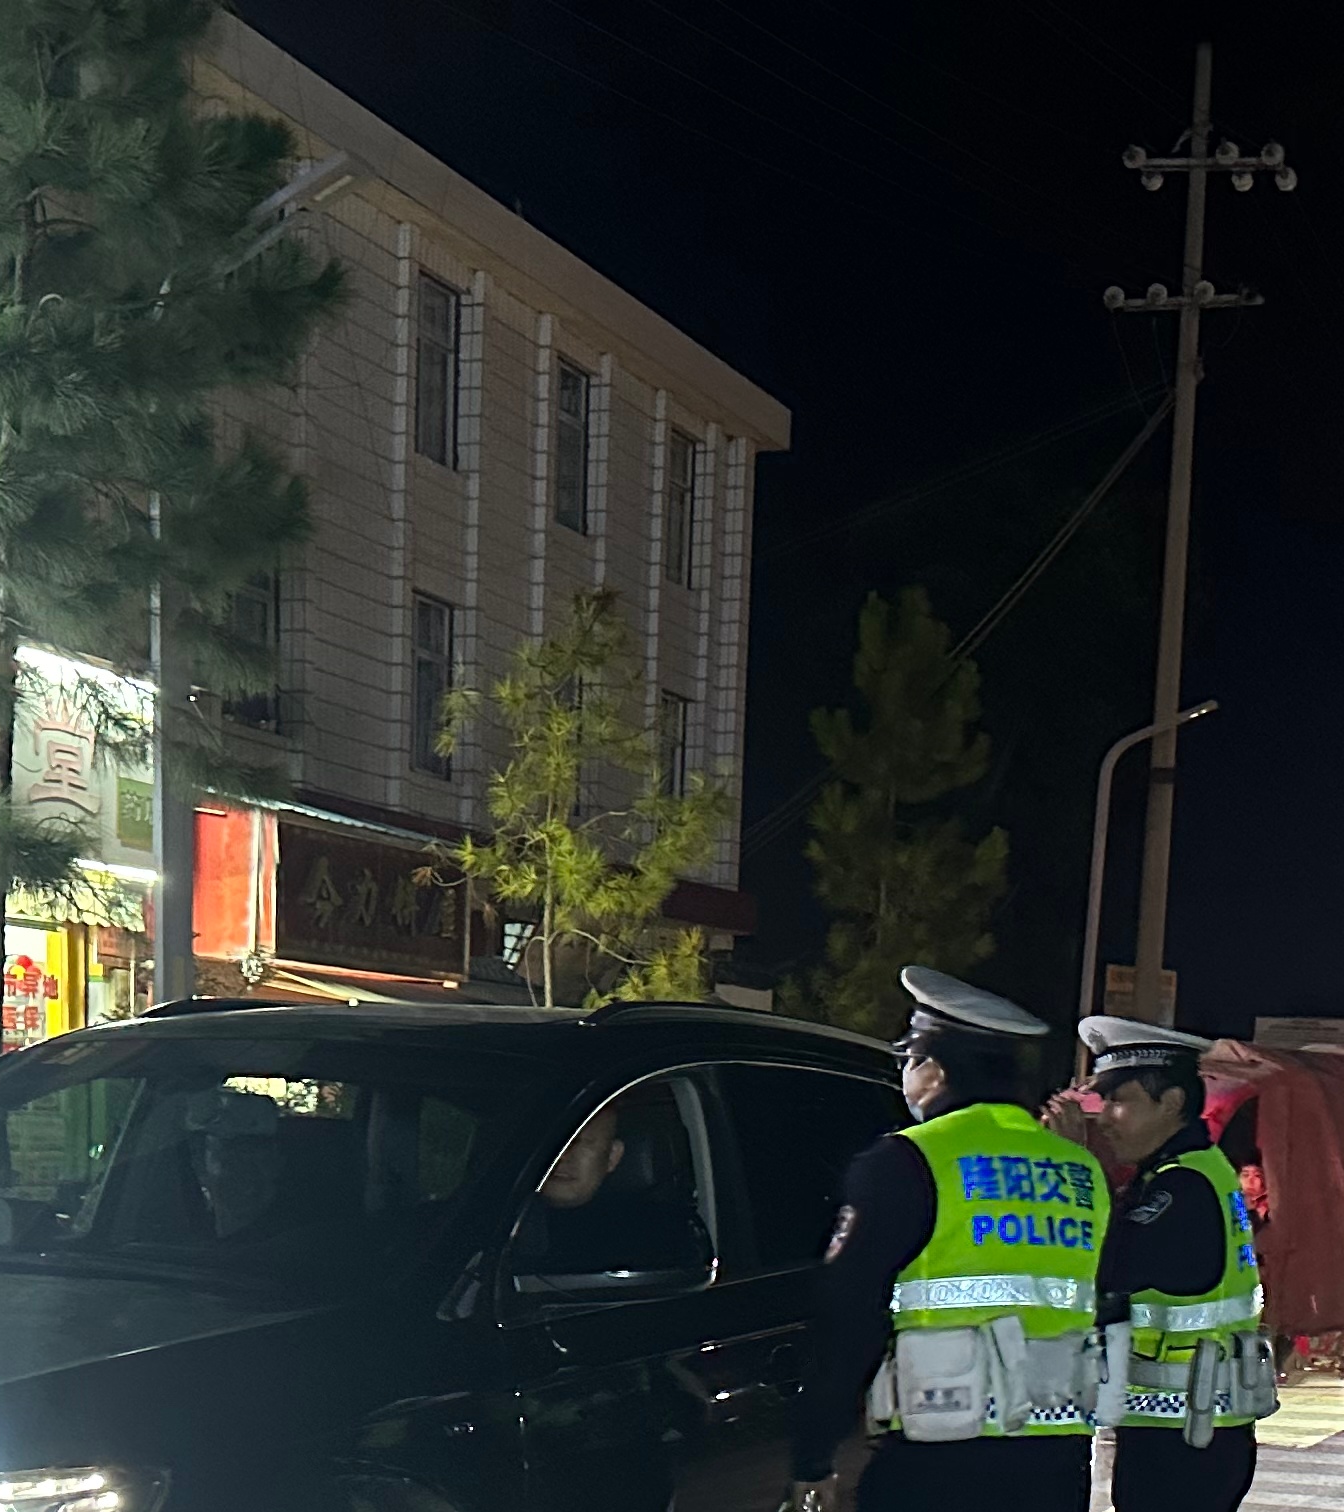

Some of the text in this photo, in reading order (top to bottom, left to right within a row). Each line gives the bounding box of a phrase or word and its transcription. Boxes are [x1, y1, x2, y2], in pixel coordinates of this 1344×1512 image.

[957, 1155, 1094, 1211] 隆阳交警
[971, 1213, 1095, 1251] POLICE
